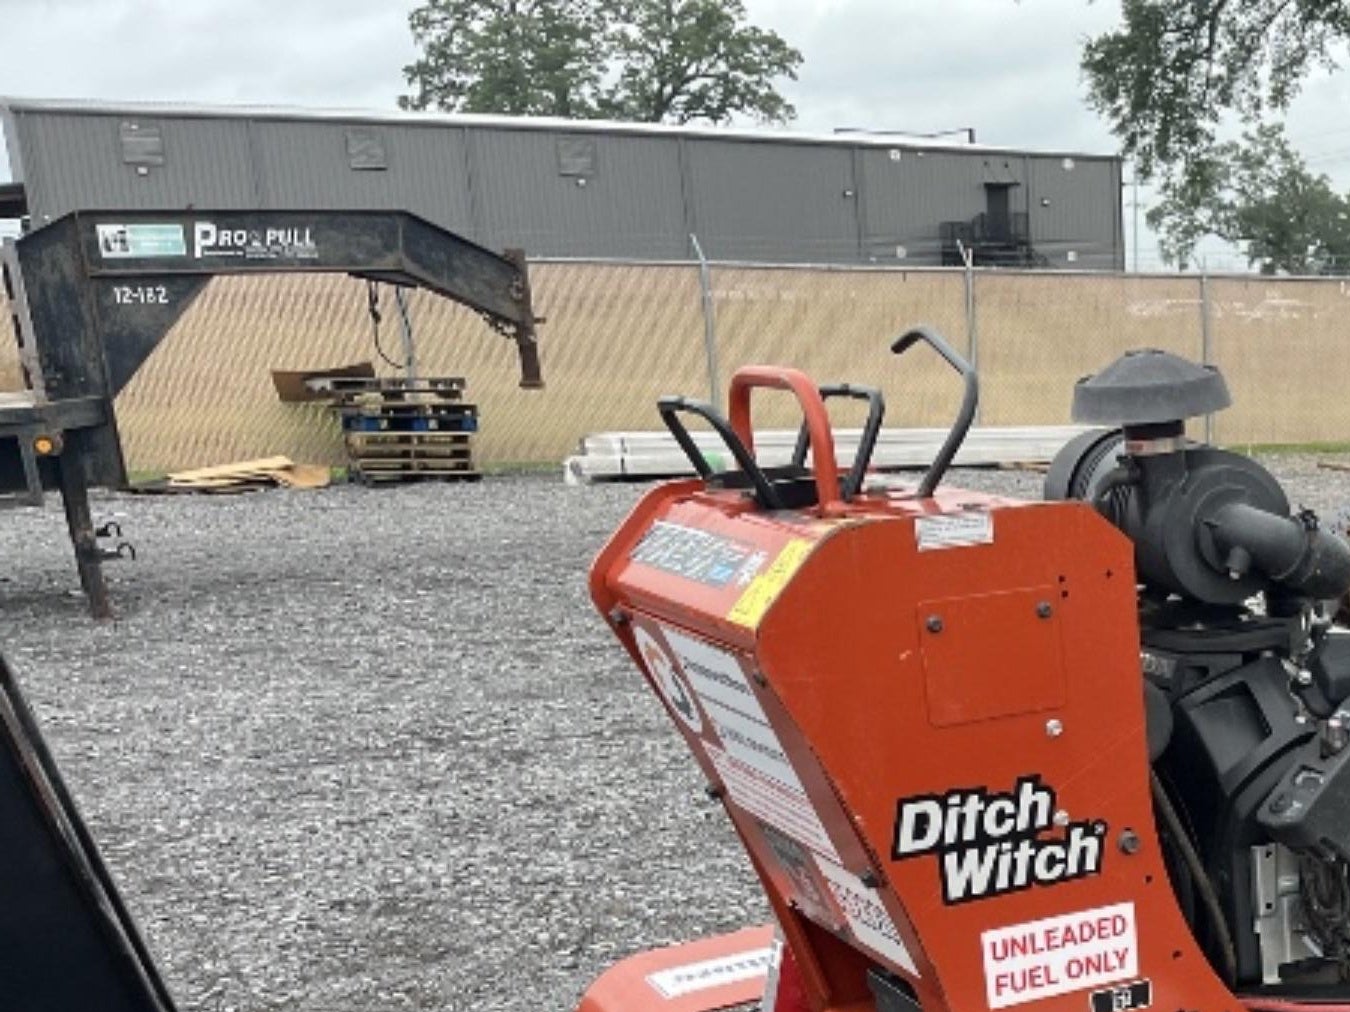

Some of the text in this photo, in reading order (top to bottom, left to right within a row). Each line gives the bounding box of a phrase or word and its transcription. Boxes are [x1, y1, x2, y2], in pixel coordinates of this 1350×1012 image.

[194, 221, 247, 258] PRO
[266, 227, 315, 248] PULL
[898, 781, 1053, 854] Ditch
[943, 826, 1102, 901] Witch
[989, 914, 1128, 962] UNLEADED
[994, 947, 1130, 997] FUEL ONLY
